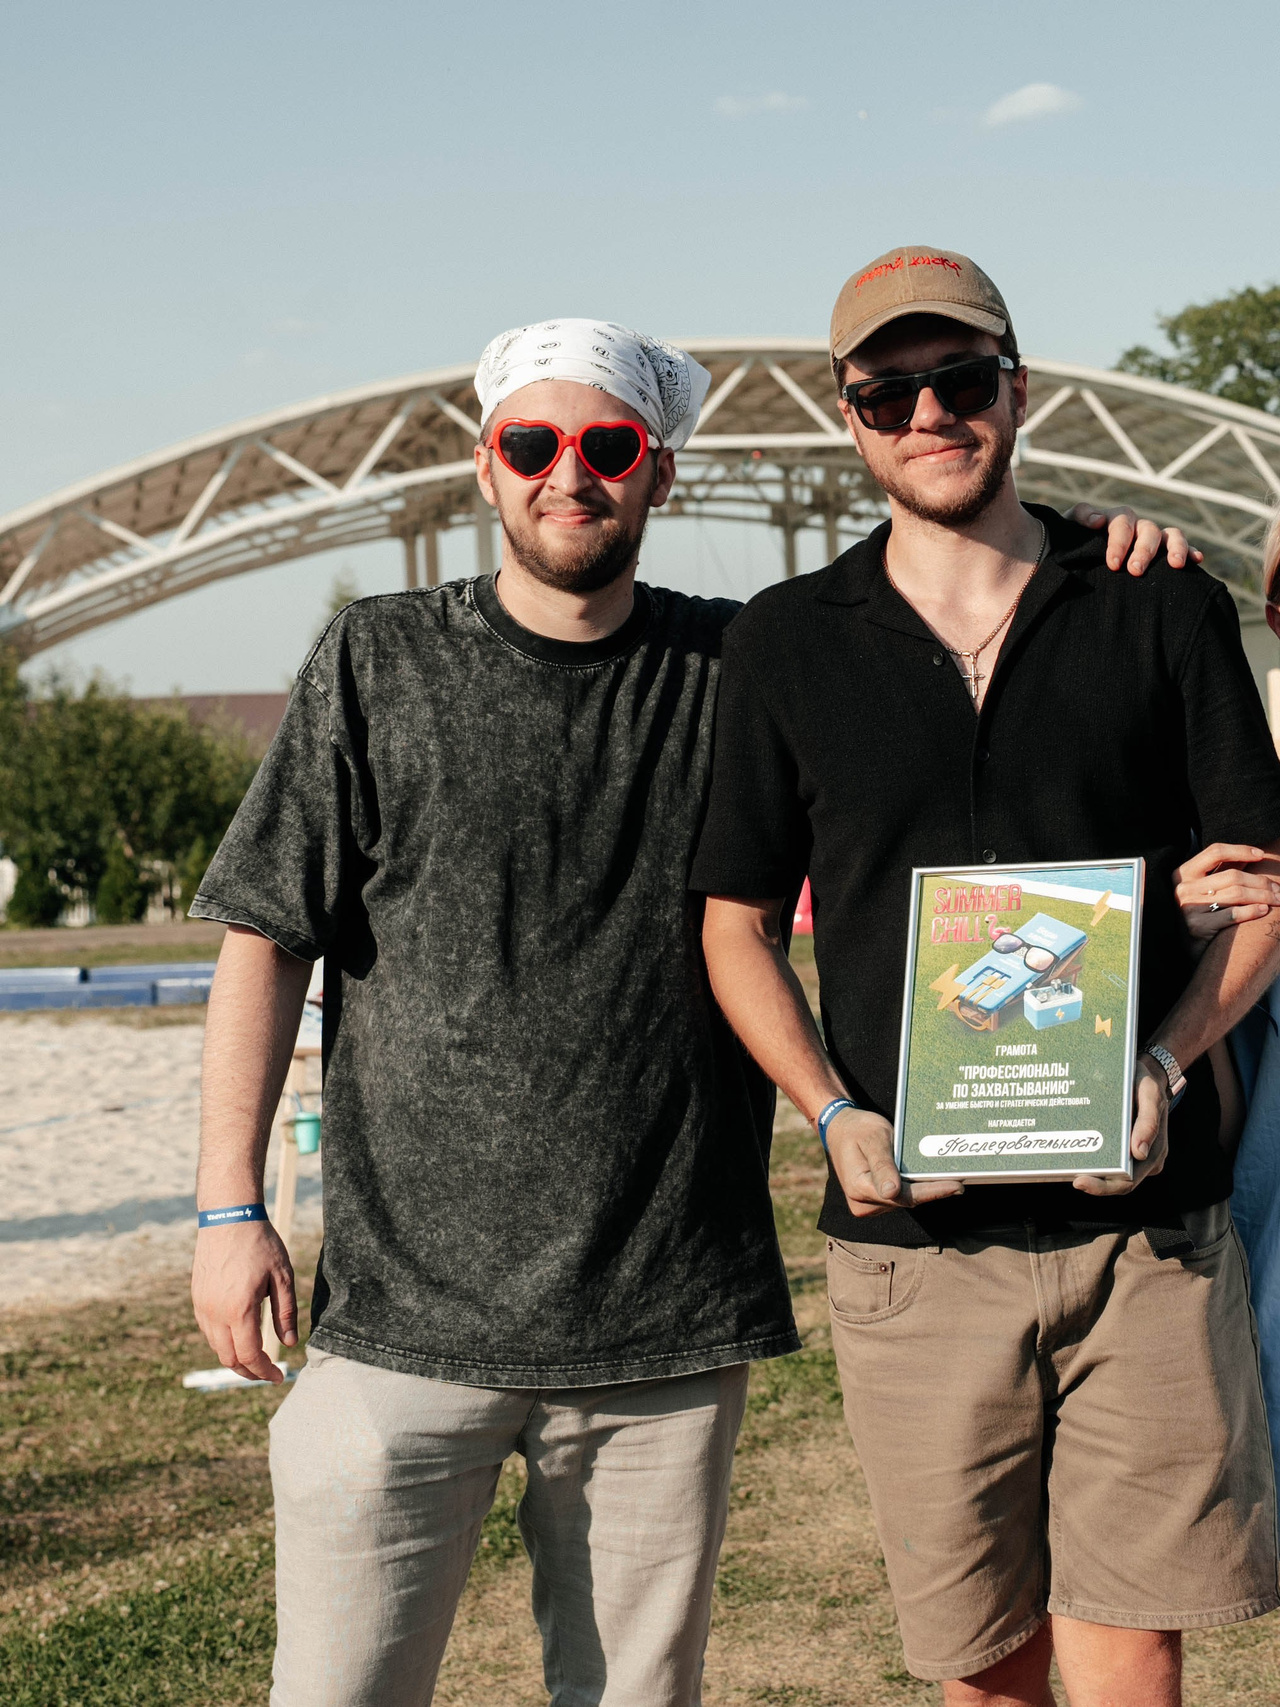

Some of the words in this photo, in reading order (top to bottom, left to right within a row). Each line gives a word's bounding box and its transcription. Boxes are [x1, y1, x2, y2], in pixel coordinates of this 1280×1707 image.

[933, 884, 1022, 914] SUMMER
[931, 915, 985, 944] CHILL
[995, 1044, 1037, 1056] ГРАМОТА
[959, 1063, 1069, 1080] "ПРОФЕССИОНАЛЫ
[952, 1084, 968, 1098] ПО
[971, 1080, 1075, 1098] ЗАХВАТЫВАНИЮ"
[945, 1101, 969, 1109] УМЕНИЕ
[970, 1100, 994, 1108] БЫСТРО
[1000, 1099, 1048, 1107] СТРАТЕГИЧЕСКИ
[1049, 1097, 1091, 1106] ДЕЙСТВОВАТЬ
[988, 1119, 1036, 1127] НАГРАЖДАЕТСЯ
[938, 1135, 1100, 1155] Последовательность
